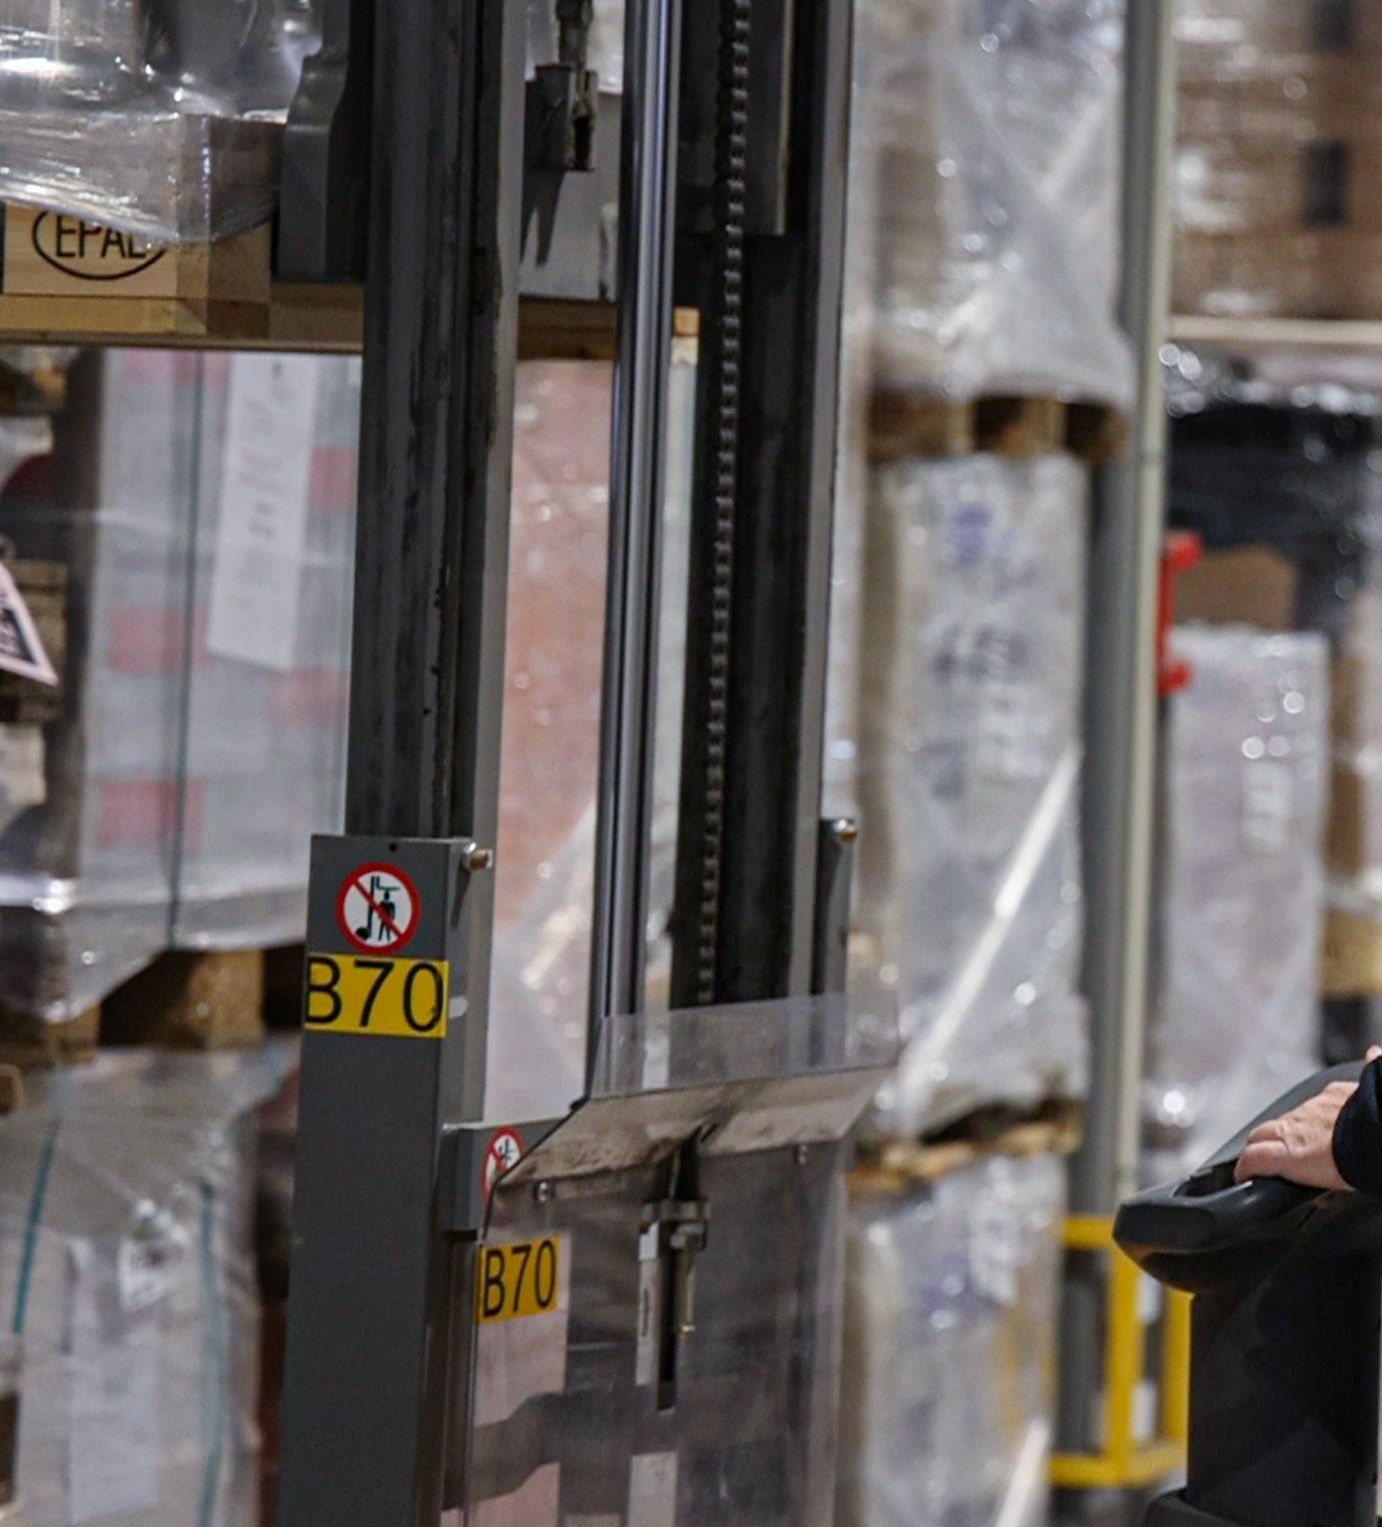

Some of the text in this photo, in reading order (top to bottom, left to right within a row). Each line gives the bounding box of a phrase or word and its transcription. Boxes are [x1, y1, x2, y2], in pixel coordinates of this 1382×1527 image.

[56, 213, 147, 259] EPAL
[305, 956, 444, 1032] B70
[483, 1240, 557, 1317] B70
